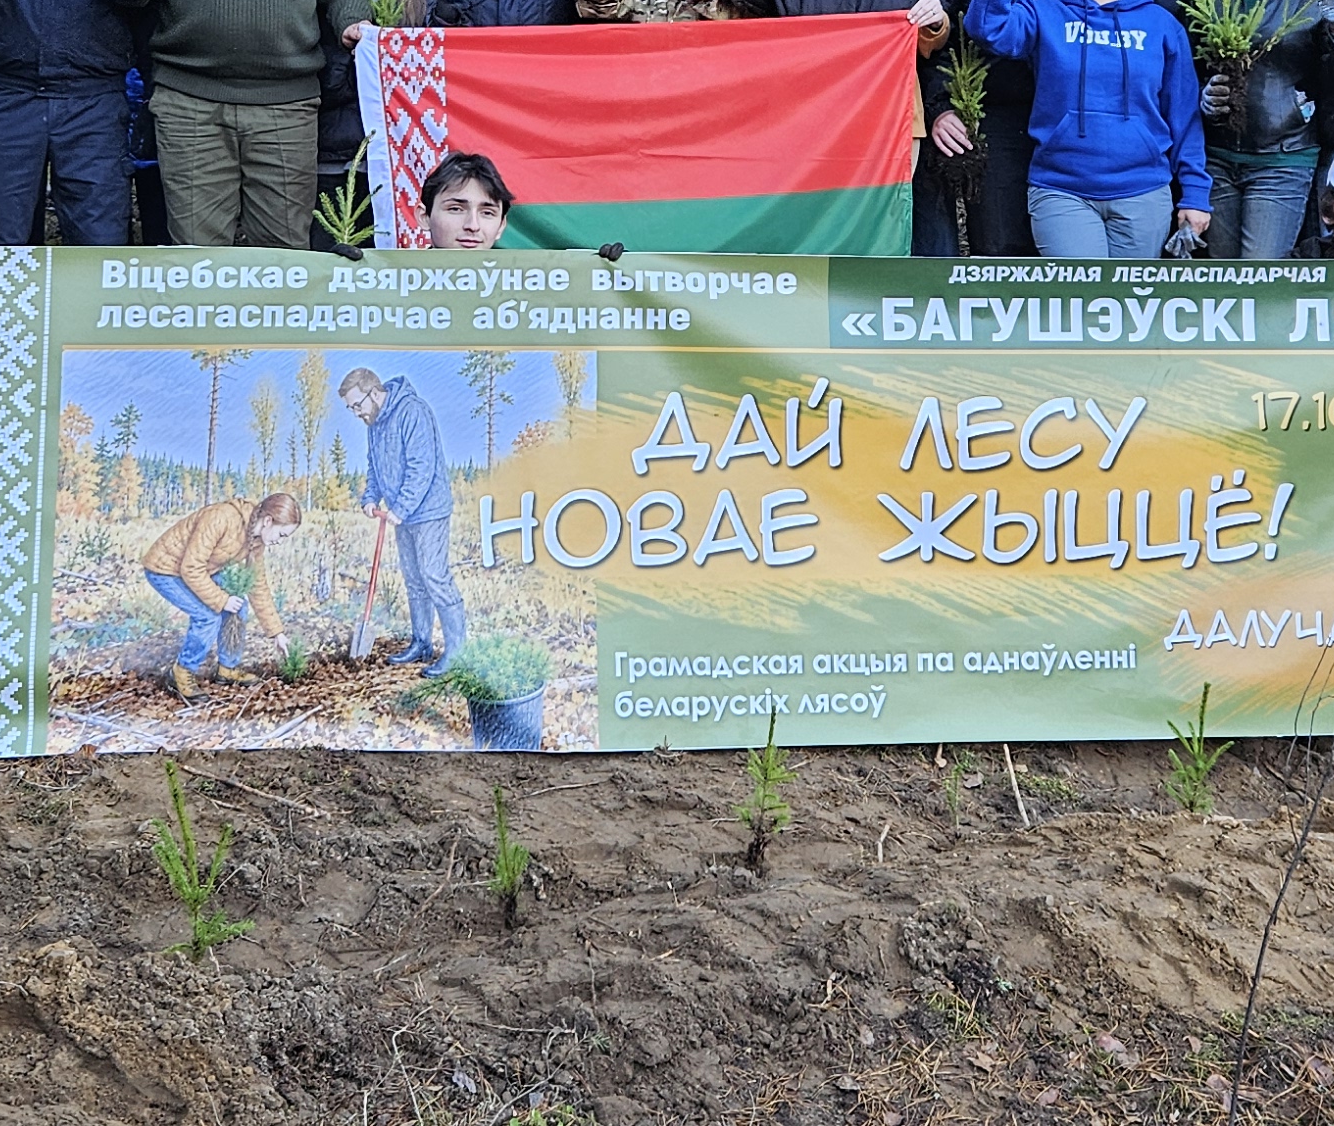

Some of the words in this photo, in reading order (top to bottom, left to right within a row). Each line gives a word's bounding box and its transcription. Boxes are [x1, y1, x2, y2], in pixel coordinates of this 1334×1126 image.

[101, 258, 308, 293] Віцебскае
[328, 260, 570, 297] дзяржаўнае
[591, 269, 798, 299] вытворчае
[948, 263, 1102, 284] ДЗЯРЖАЎНАЯ
[1112, 266, 1327, 285] ЛЕСАГАСПАДАРЧАЯ
[97, 304, 452, 335] лесагаспадарчае
[841, 286, 1257, 343] «БАГУШЭЎСКІ
[630, 376, 843, 475] ДАЙ
[899, 395, 1147, 471] ЛЕСУ
[479, 488, 819, 568] НОВАЕ
[876, 468, 1295, 570] ЖЫЦЦЁ!
[614, 651, 804, 683] Грамадская
[812, 653, 908, 676] акцыя
[917, 651, 954, 673] па
[963, 643, 1138, 677] аднаўленні
[614, 687, 791, 722] беларускіх
[797, 684, 887, 719] лясоў
